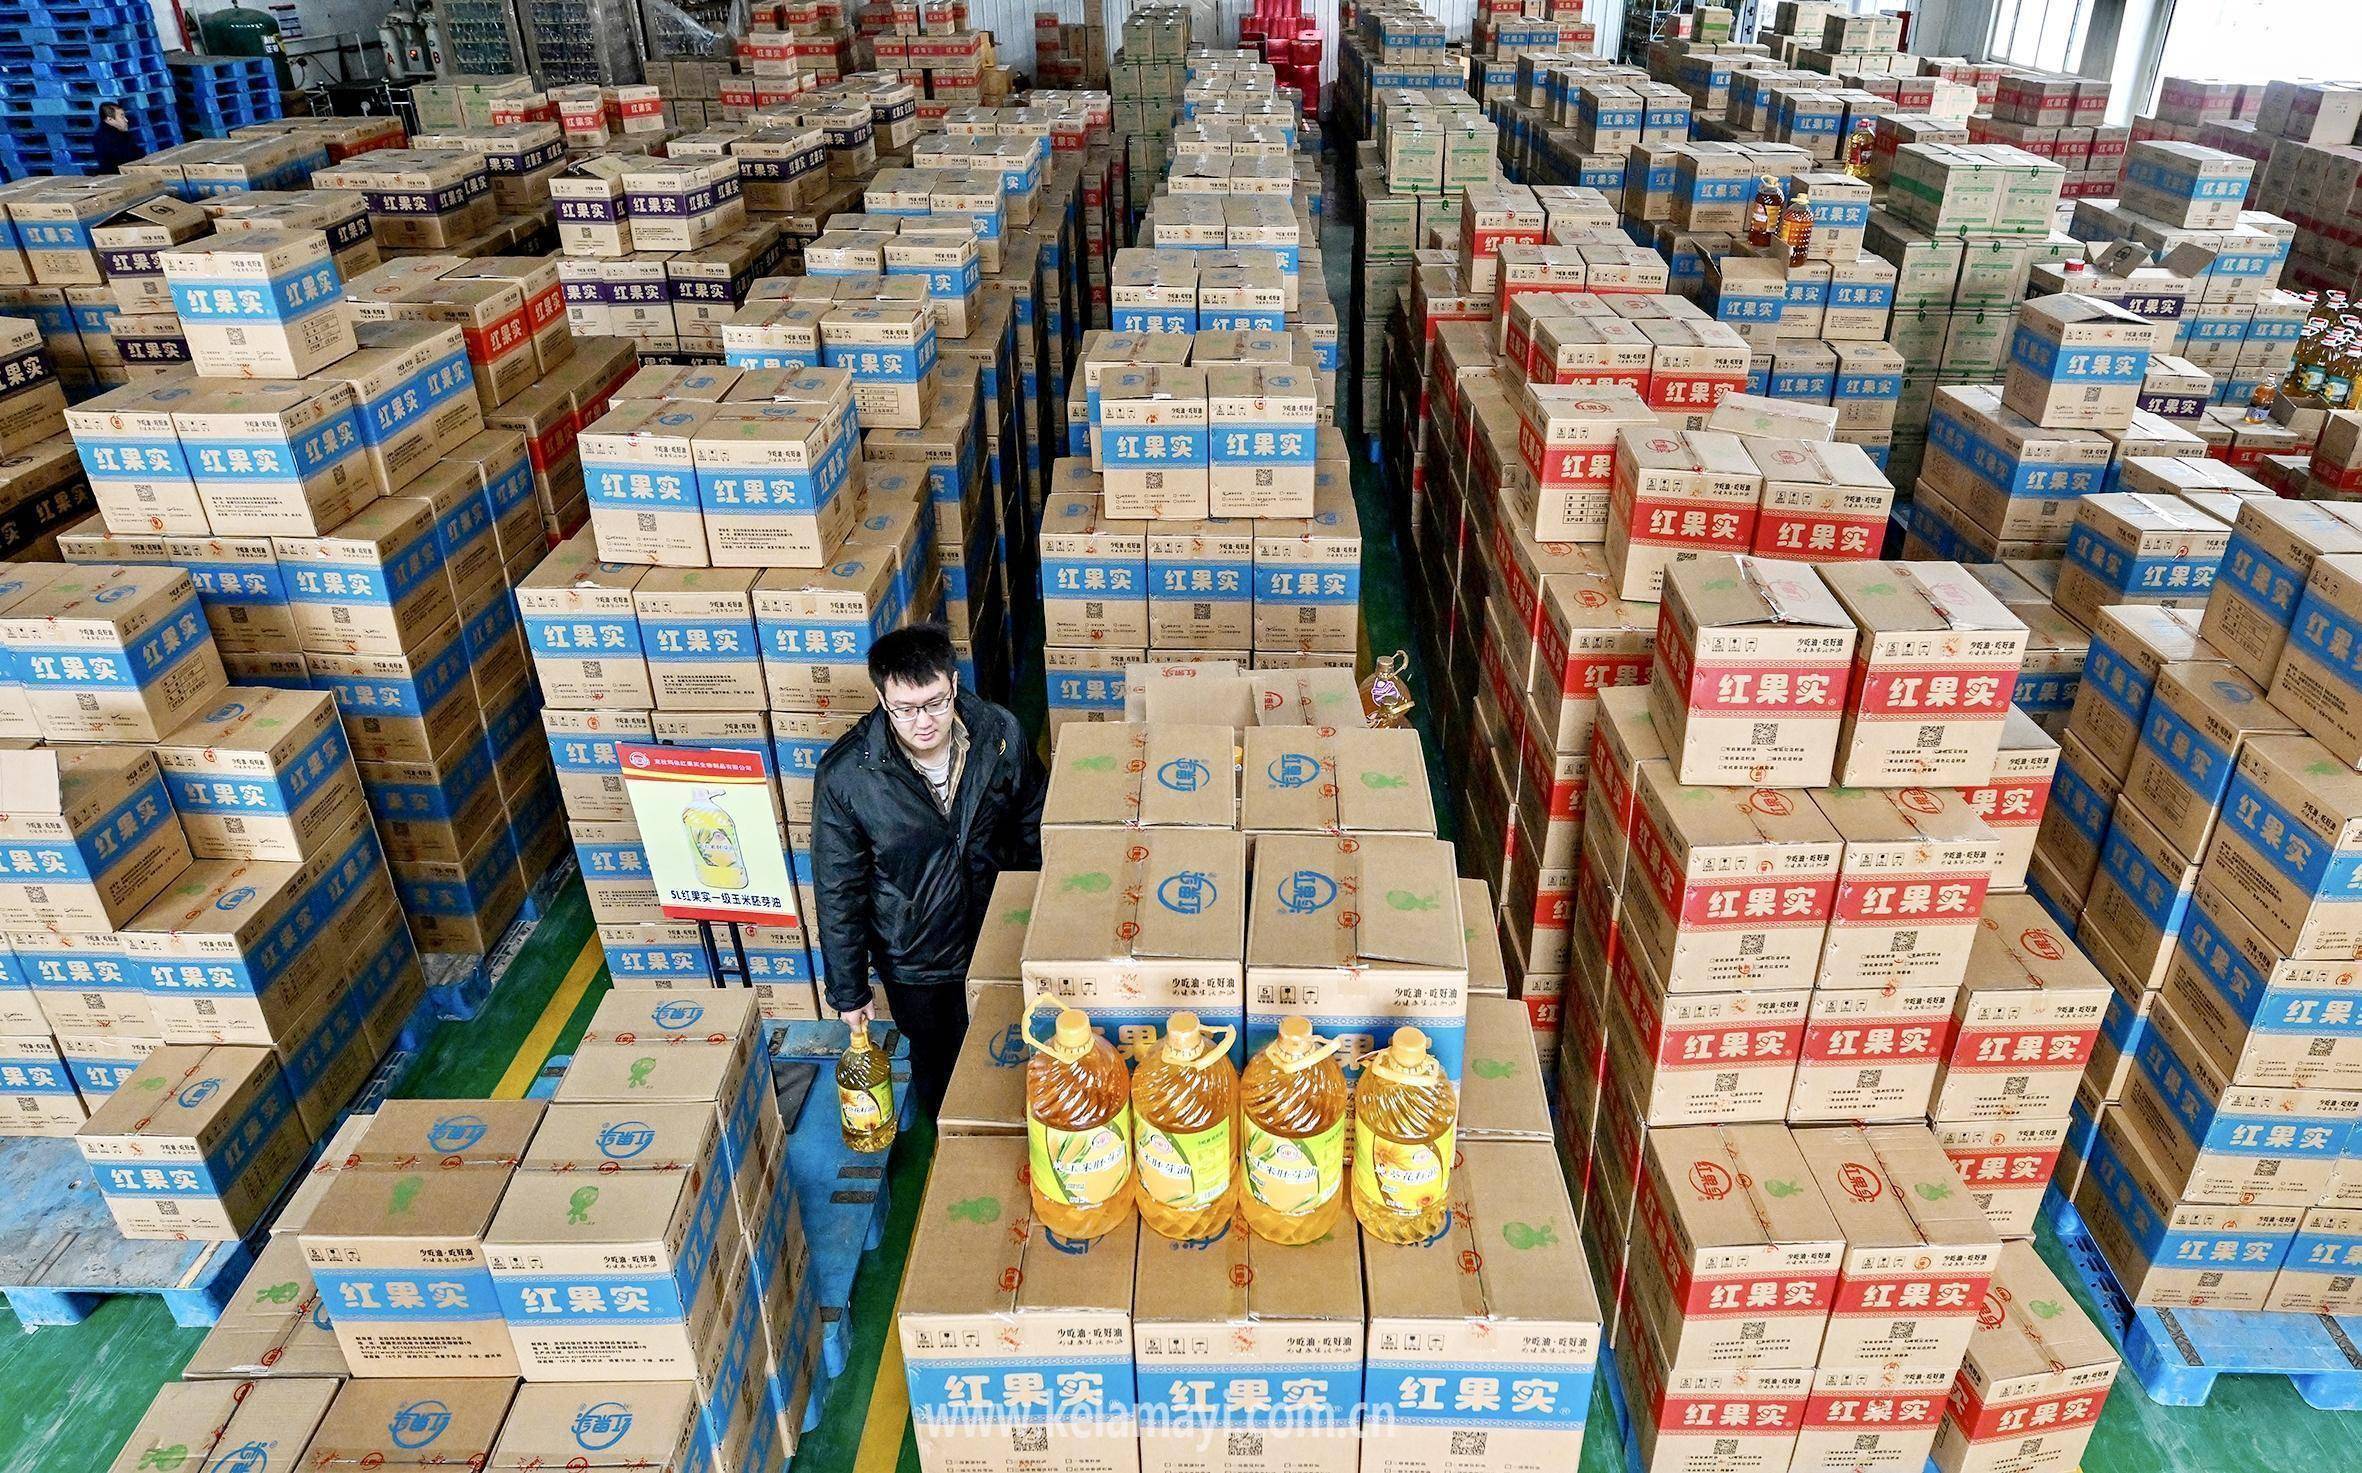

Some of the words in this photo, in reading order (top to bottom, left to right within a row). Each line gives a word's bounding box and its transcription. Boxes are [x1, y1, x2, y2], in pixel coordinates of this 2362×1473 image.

[387, 52, 395, 65] A
[433, 52, 440, 64] B
[631, 103, 652, 113] 红果实
[566, 117, 593, 126] 红果实
[1602, 115, 1641, 126] 红果实
[1651, 114, 1684, 124] 红果实
[1800, 118, 1835, 129] 红果实
[741, 164, 778, 176] 红果实
[464, 176, 487, 194] 红果实
[718, 180, 739, 199] 红果实
[1700, 183, 1741, 197] 红果实
[2202, 182, 2242, 195] 红果实
[383, 192, 430, 211] 红果实
[440, 189, 464, 208] 红果实
[633, 198, 675, 212] 红果实
[689, 192, 711, 211] 红果实
[562, 203, 604, 218] 红果实
[1814, 207, 1860, 221] 红果实
[2221, 258, 2264, 271] 红果实
[286, 270, 333, 307] 红果实
[614, 285, 659, 299] 红果实
[679, 283, 723, 298] 红果实
[1838, 288, 1883, 303] 红果实
[187, 290, 264, 313] 红果实
[535, 292, 560, 322] 红果实
[1727, 301, 1773, 316] 红果实
[2129, 299, 2177, 316] 红果实
[491, 319, 521, 351] 红果实
[2200, 324, 2241, 336] 红果实
[2256, 324, 2297, 336] 红果实
[128, 342, 180, 358] 红果实
[837, 354, 902, 374] 红果实
[2067, 355, 2136, 375] 红果实
[428, 361, 465, 396] 红果实
[1779, 379, 1824, 392] 红果实
[1846, 380, 1892, 393] 红果实
[378, 389, 418, 429] 红果实
[2147, 398, 2197, 414] 红果实
[306, 421, 354, 464] 红果实
[1117, 435, 1192, 458] 红果实
[1227, 433, 1302, 456] 红果实
[94, 448, 172, 471] 红果实
[200, 449, 279, 473] 红果实
[601, 473, 681, 500] 红果实
[1713, 483, 1752, 492] 少吃油·吃好油
[2026, 471, 2091, 490] 红果实
[714, 479, 795, 504] 红果实
[1844, 496, 1882, 505] 少吃油·吃好油
[1649, 509, 1739, 539] 红果实
[1777, 523, 1869, 552] 红果实
[192, 573, 268, 594] 红果实
[297, 572, 372, 595] 红果实
[1058, 568, 1131, 590] 红果实
[1165, 570, 1239, 591] 红果实
[1271, 573, 1346, 595] 红果实
[2142, 566, 2216, 587] 红果实
[2232, 550, 2293, 609] 红果实
[143, 613, 197, 668] 红果实
[544, 625, 625, 647] 红果实
[657, 629, 738, 652] 红果实
[776, 630, 856, 653] 红果实
[1797, 639, 1843, 647] 少吃油·吃好油
[1969, 641, 2015, 649] 少吃油·吃好油
[31, 657, 118, 680] 红果实
[1717, 674, 1829, 704] 红果实
[1887, 676, 1999, 706] 红果实
[2153, 719, 2212, 779] 红果实
[291, 739, 337, 794] 红果实
[2010, 757, 2050, 765] 少吃油·吃好油
[184, 782, 267, 808] 红果实
[95, 796, 157, 858] 红果实
[2237, 795, 2312, 871] 红果实
[1786, 854, 1830, 862] 少吃油·吃好油
[1943, 851, 1987, 859] 少吃油·吃好油
[1707, 887, 1816, 918] 红果实
[1861, 884, 1970, 914] 红果实
[39, 961, 123, 982] 红果实
[622, 952, 694, 970] 红果实
[2194, 926, 2250, 1002] 红果实
[151, 966, 236, 987] 红果实
[1173, 977, 1236, 988] 少吃油·吃好油
[1394, 987, 1458, 998] 少吃油·吃好油
[2055, 1005, 2098, 1014] 少吃油·吃好油
[1683, 1031, 1786, 1059] 红果实
[1827, 1027, 1931, 1054] 红果实
[1978, 1035, 2081, 1061] 红果实
[2230, 1124, 2332, 1149] 红果实
[111, 1169, 199, 1189] 红果实
[419, 1248, 474, 1257] 少吃油·吃好油
[603, 1255, 657, 1263] 少吃油·吃好油
[2176, 1240, 2273, 1261] 红果实
[339, 1282, 468, 1308] 红果实
[521, 1286, 649, 1313] 红果实
[1709, 1281, 1817, 1308] 红果实
[1862, 1283, 1970, 1307] 红果实
[1057, 1327, 1125, 1337] 少吃油·吃好油
[1285, 1336, 1353, 1346] 少吃油·吃好油
[1522, 1336, 1588, 1346] 少吃油·吃好油
[944, 1372, 1103, 1407] 红果实
[1169, 1378, 1328, 1412] 红果实
[1399, 1376, 1559, 1413] 红果实
[1684, 1404, 1787, 1426] 红果实
[1827, 1399, 1930, 1421] 红果实
[1997, 1398, 2092, 1432] 红果实
